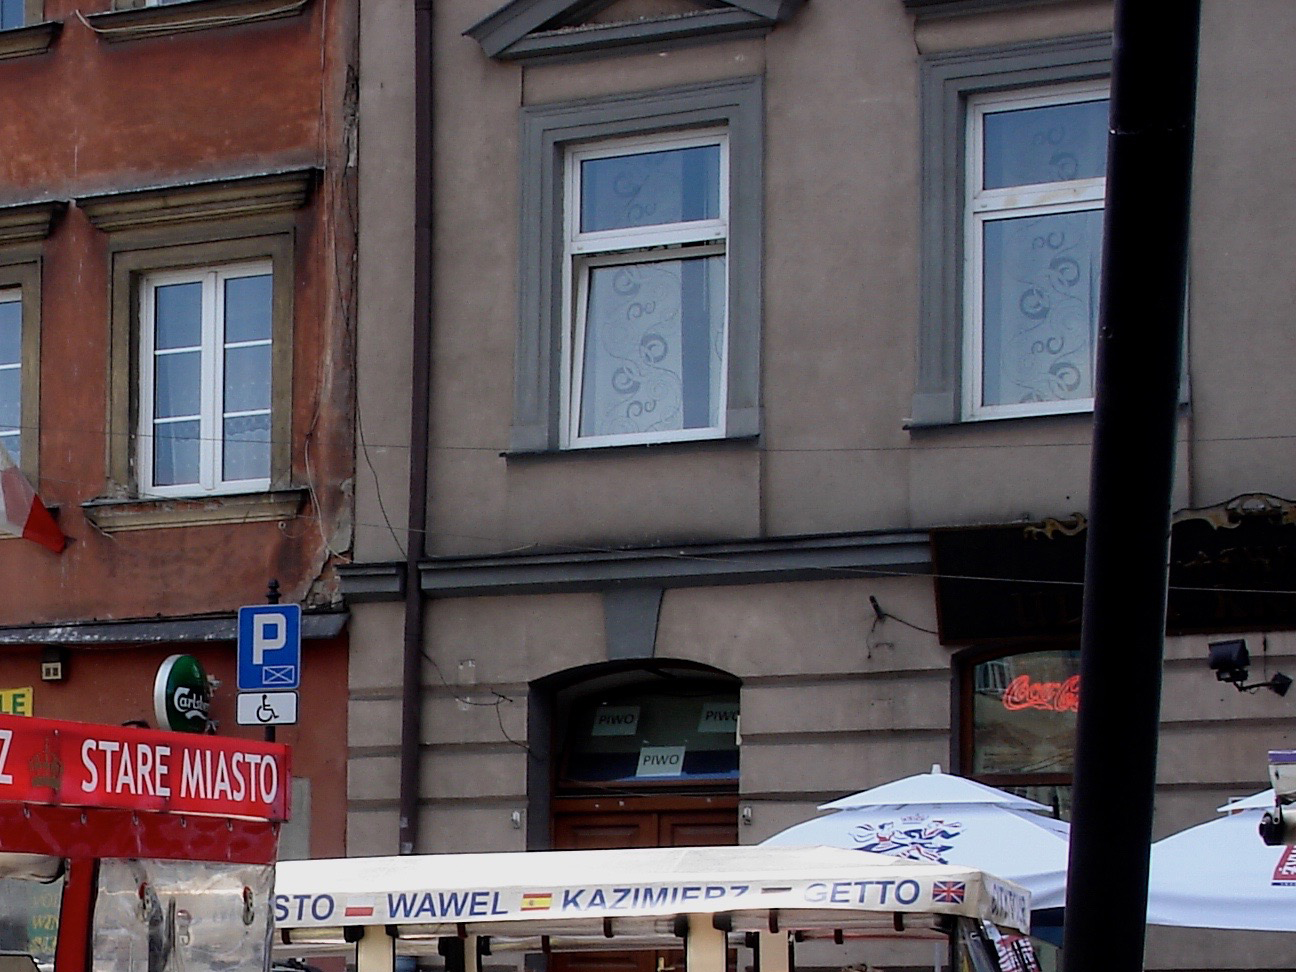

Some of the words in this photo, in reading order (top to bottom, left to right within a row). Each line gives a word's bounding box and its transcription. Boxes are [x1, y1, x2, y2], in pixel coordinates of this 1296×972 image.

[252, 612, 287, 665] P
[597, 712, 635, 725] PIWO
[80, 738, 172, 797] STARE
[179, 747, 279, 805] MIASTO
[642, 753, 681, 767] PIWO
[386, 890, 509, 919] WAWEL
[804, 878, 921, 906] GETTO
[274, 892, 336, 922] STO
